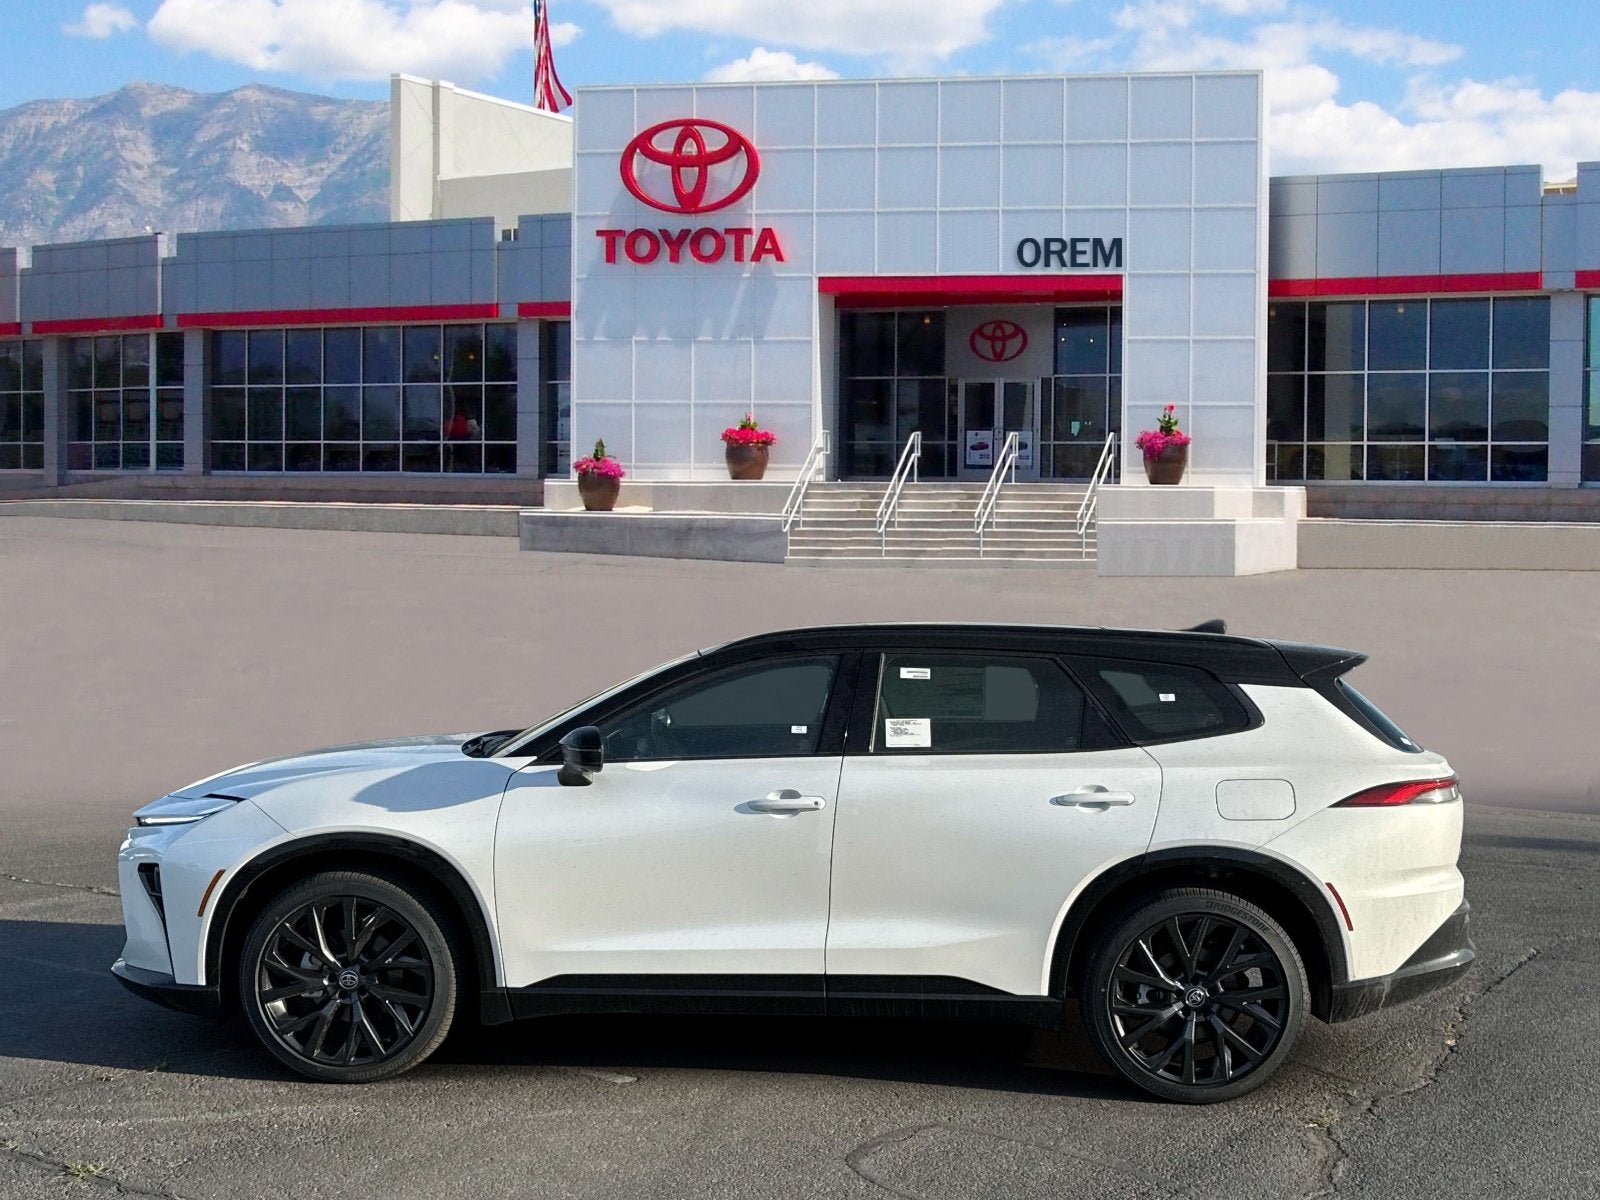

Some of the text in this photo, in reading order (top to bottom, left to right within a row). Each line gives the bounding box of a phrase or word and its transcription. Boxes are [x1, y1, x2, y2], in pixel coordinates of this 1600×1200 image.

[596, 227, 784, 264] TOYOTA
[1016, 237, 1123, 269] OREM
[1205, 899, 1271, 934] BRIDGESTONE
